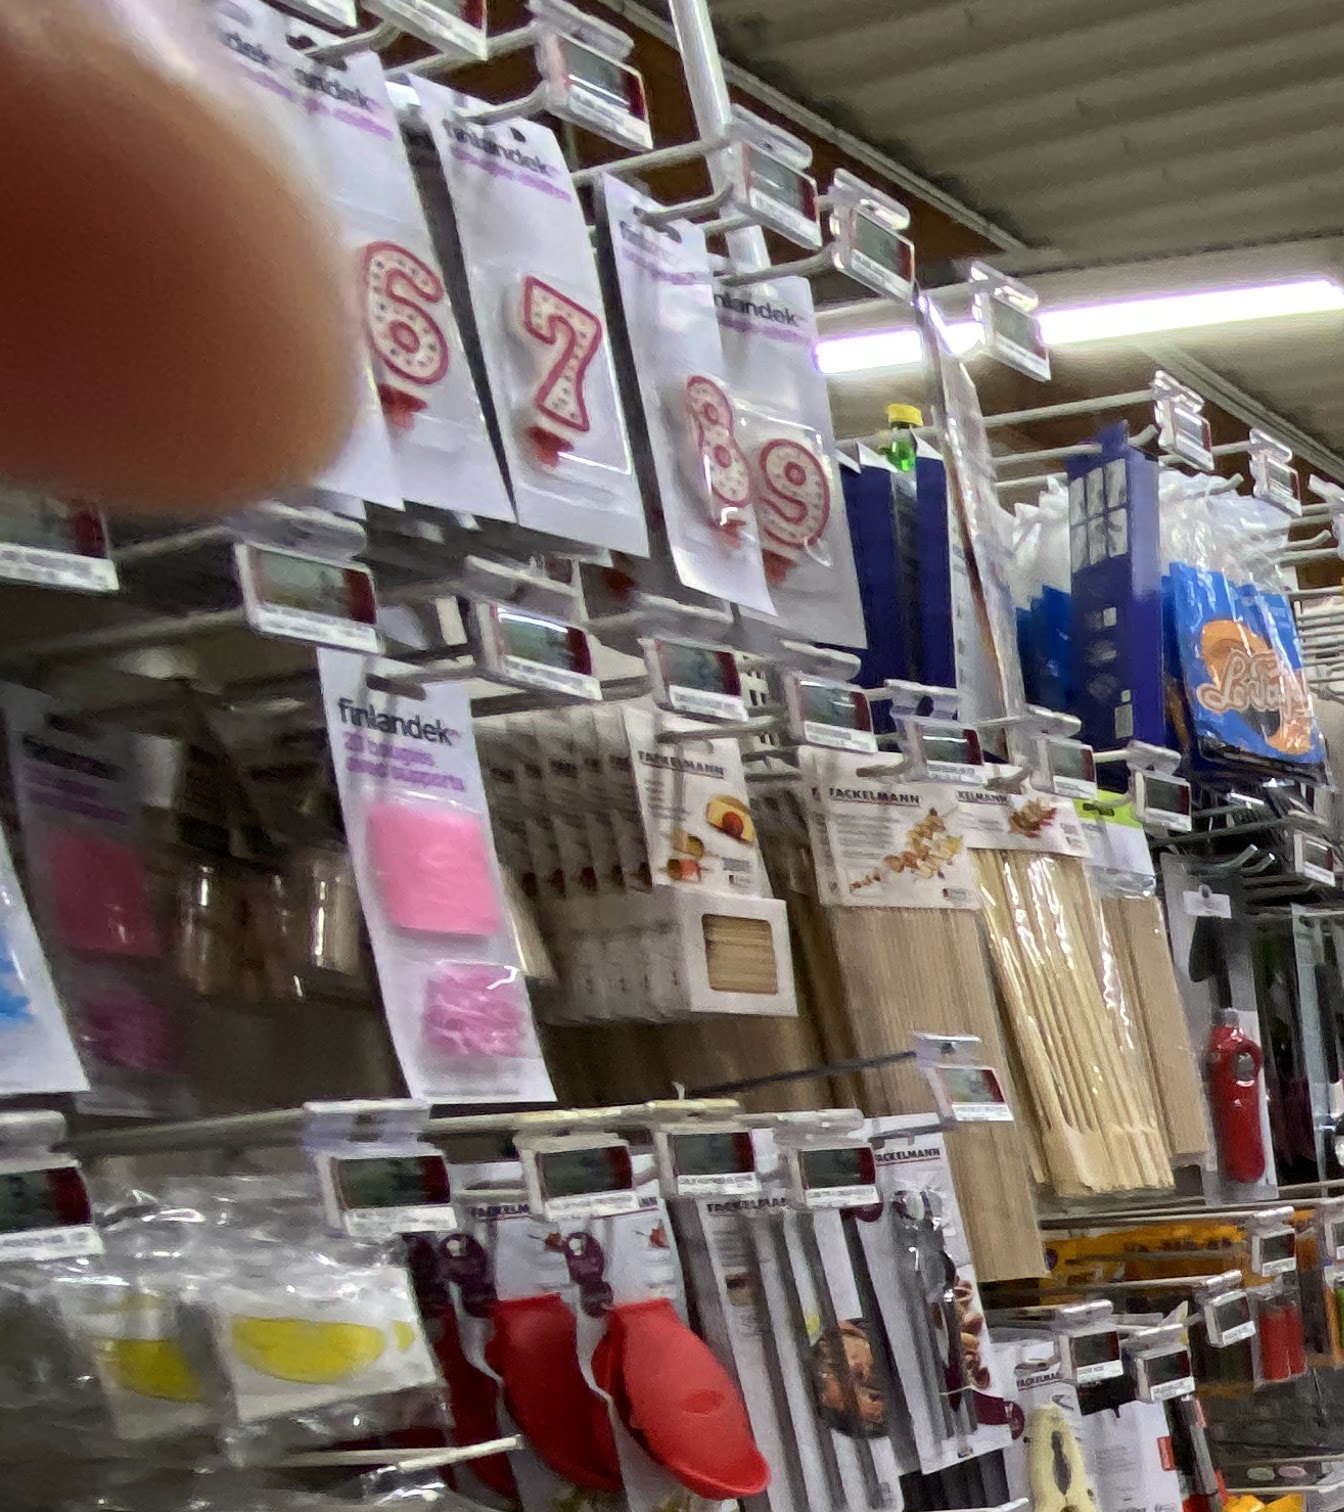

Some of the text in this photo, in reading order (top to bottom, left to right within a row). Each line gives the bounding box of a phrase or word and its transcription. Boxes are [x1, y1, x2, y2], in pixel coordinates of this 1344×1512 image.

[361, 241, 449, 385] 6
[715, 292, 799, 325] nlandek
[522, 275, 601, 433] 7
[686, 375, 750, 506] 8
[757, 437, 832, 550] 9
[338, 697, 453, 746] finlandek
[828, 787, 920, 804] FACKELMANN
[957, 790, 1008, 803] KELMANN
